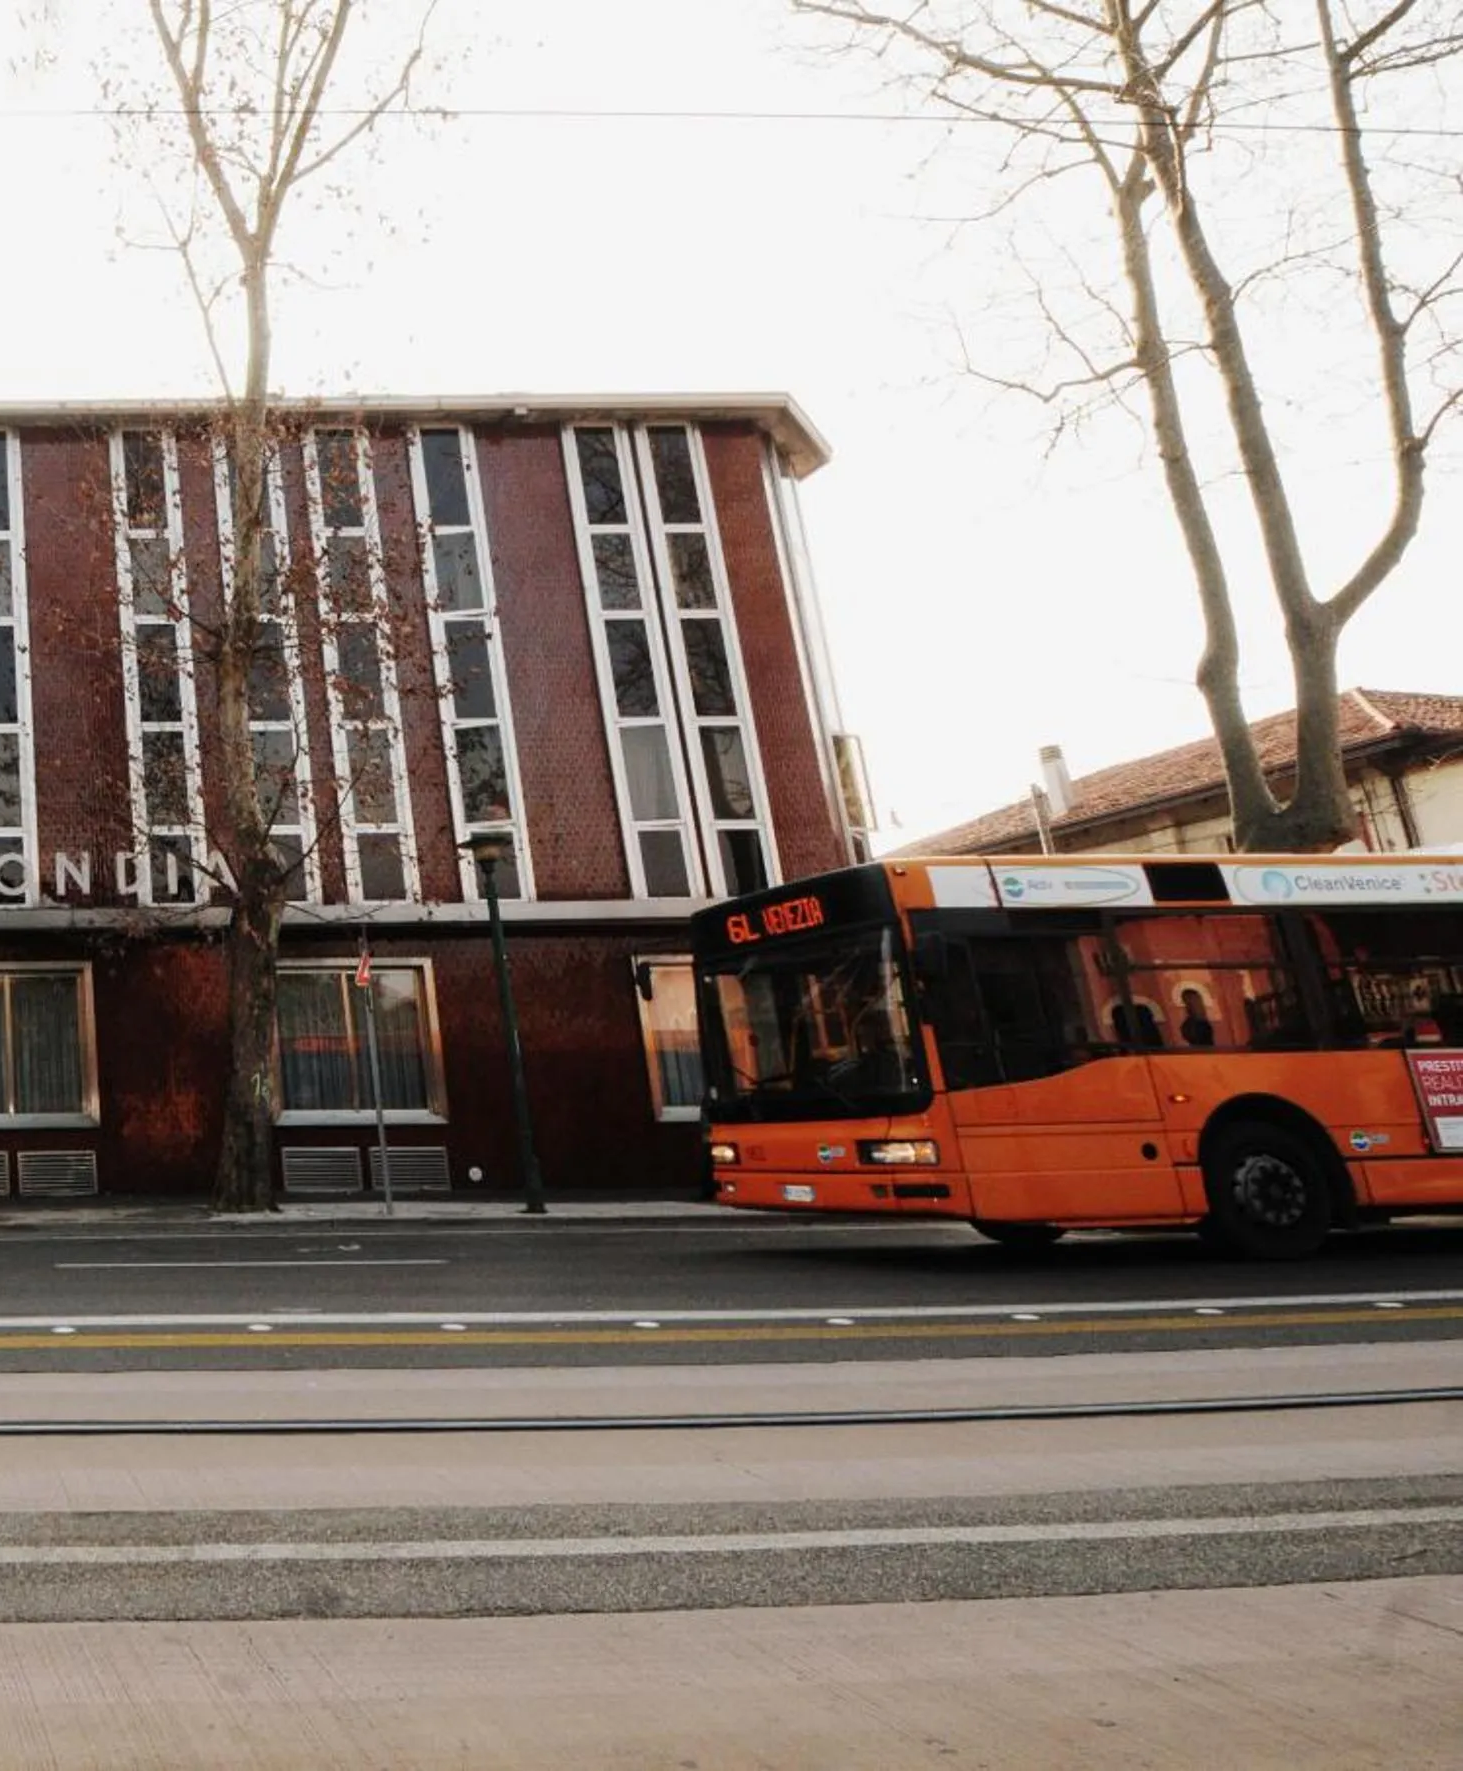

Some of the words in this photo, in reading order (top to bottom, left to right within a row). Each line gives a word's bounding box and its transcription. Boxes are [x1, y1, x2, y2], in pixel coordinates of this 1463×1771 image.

[1294, 874, 1402, 892] CleanVenice
[726, 912, 761, 944] 6L
[762, 896, 825, 936] VENEZIA
